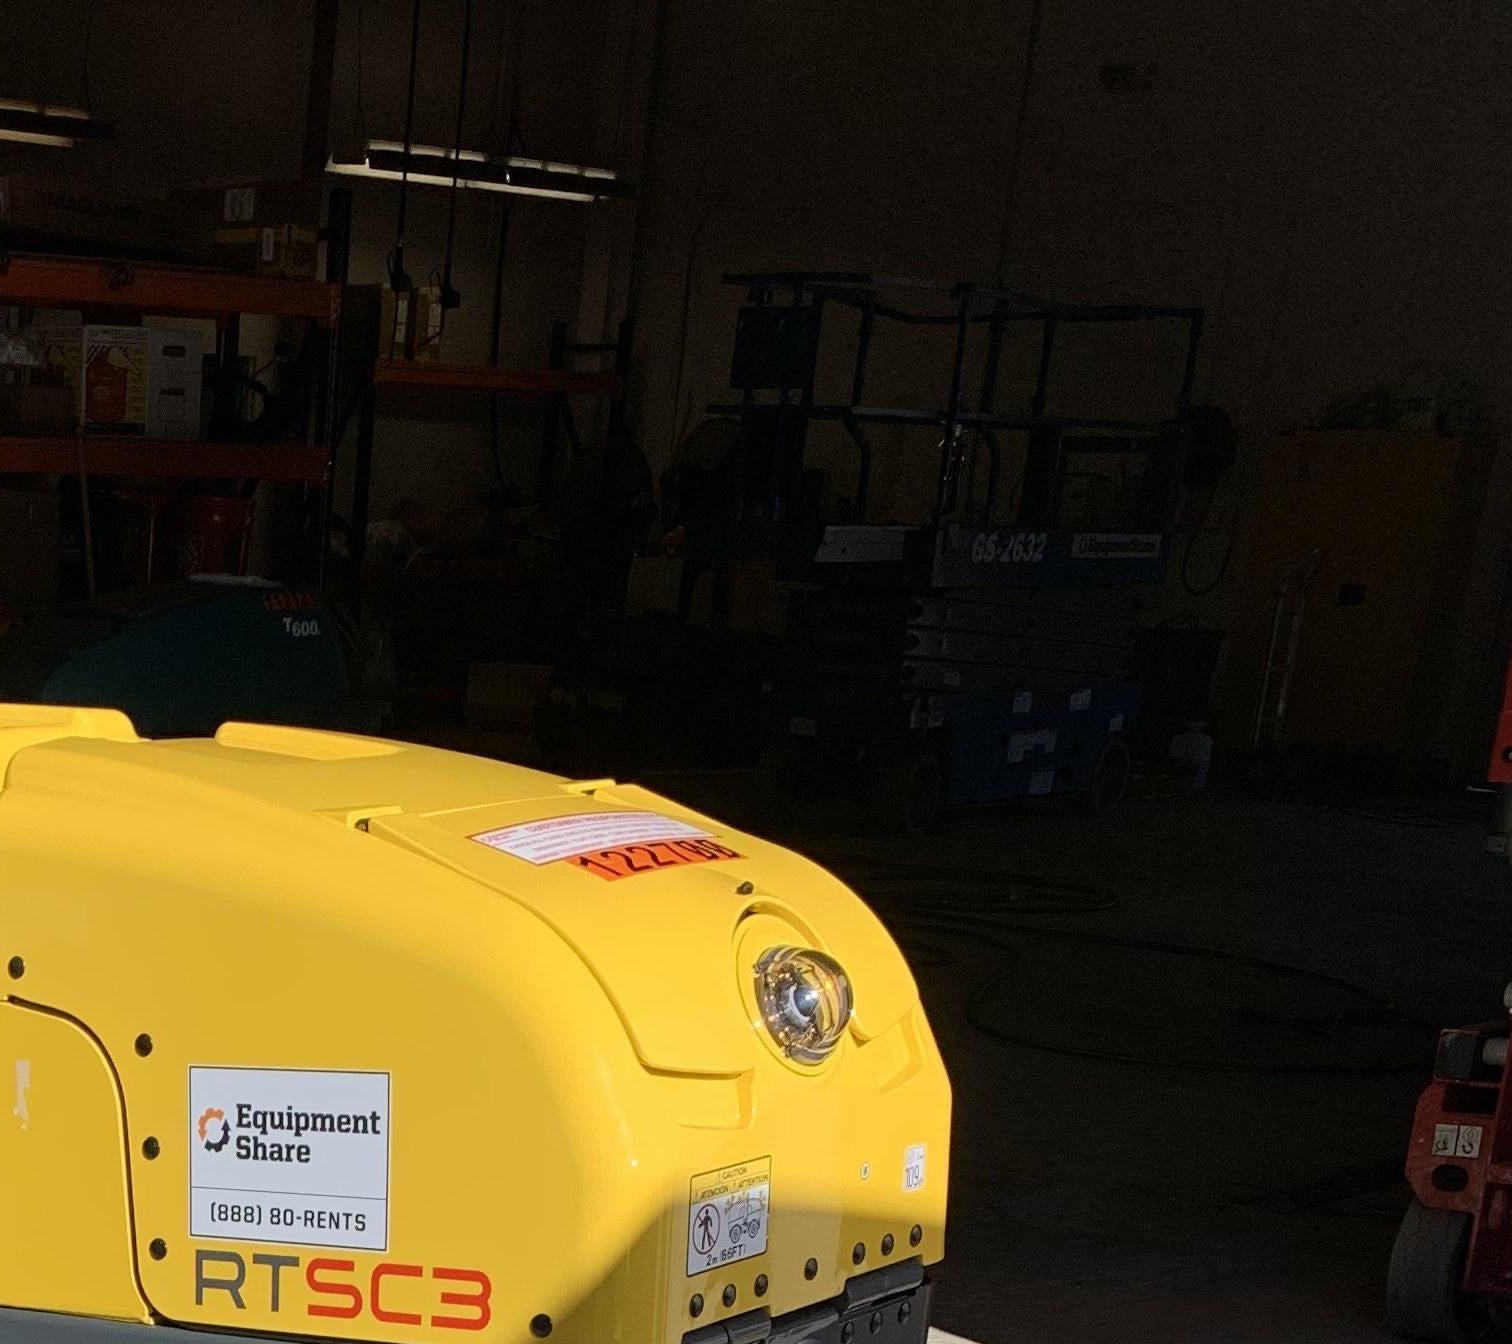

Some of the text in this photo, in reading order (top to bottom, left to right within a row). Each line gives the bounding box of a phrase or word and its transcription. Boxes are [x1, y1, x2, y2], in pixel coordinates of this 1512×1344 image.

[235, 1103, 381, 1137] Equipment
[235, 1134, 312, 1164] Share
[210, 1201, 367, 1232] (888) 80-RENTS
[194, 1248, 492, 1331] RTSC3
